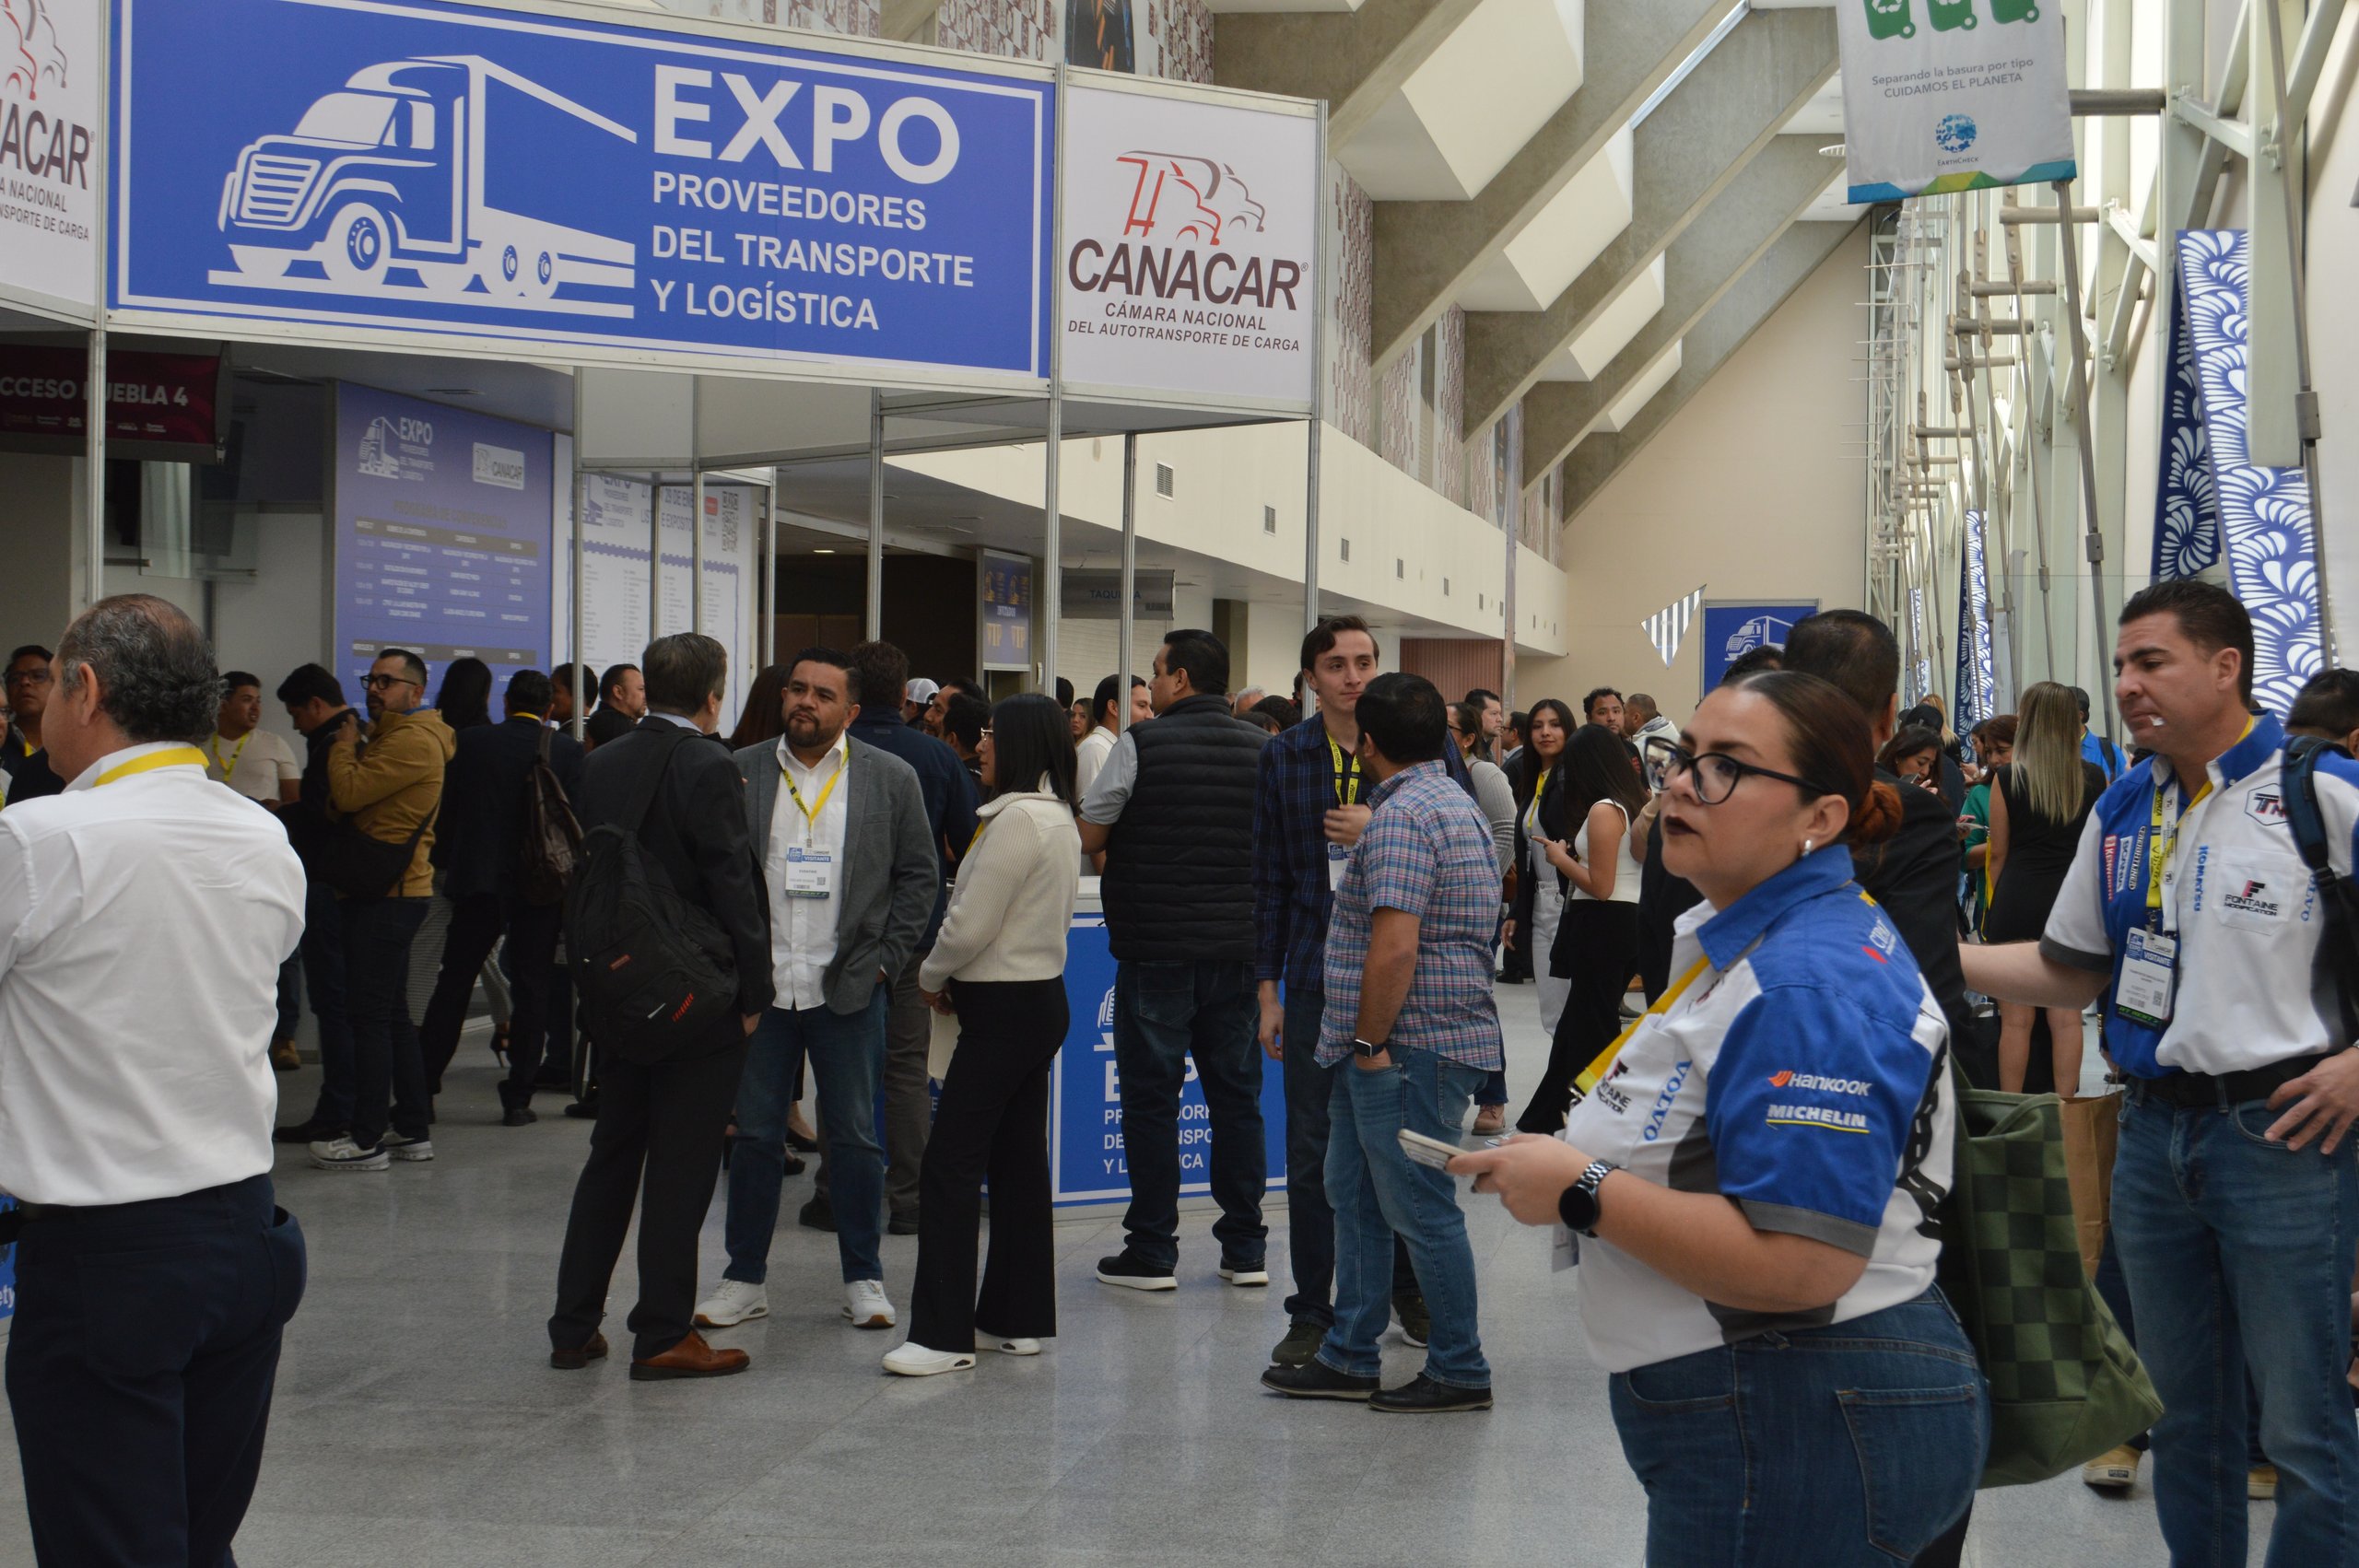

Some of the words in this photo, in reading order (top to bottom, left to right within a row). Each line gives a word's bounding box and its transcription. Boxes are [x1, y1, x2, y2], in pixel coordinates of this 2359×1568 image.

[1872, 69, 1931, 87] Separando
[1934, 67, 1944, 78] la
[1947, 64, 1984, 76] basura
[1988, 61, 2008, 75] por
[2011, 58, 2034, 72] tipo
[1884, 81, 1949, 99] CUIDAMOS
[1952, 79, 1966, 90] EL
[1969, 73, 2024, 88] PLANETA
[653, 64, 960, 184] EXPO
[0, 99, 89, 190] ACAR
[10, 178, 67, 213] NACIONAL
[652, 170, 927, 230] PROVEEDORES
[43, 215, 56, 232] DE
[58, 219, 89, 241] CARGA
[652, 225, 725, 263] DEL
[734, 232, 974, 287] TRANSPORTE
[1068, 239, 1301, 310] CANACAR
[651, 278, 676, 312] Y
[687, 281, 880, 331] LOGÍSTICA
[1105, 300, 1177, 323] CÁMARA
[1183, 309, 1267, 331] NACIONAL
[1068, 320, 1095, 334] DEL
[1099, 322, 1227, 346] AUTOTRANSPORTE
[1232, 333, 1250, 347] DE
[1254, 335, 1300, 351] CARGA
[83, 380, 169, 405] EBLA
[173, 386, 189, 406] 4
[400, 417, 433, 445] EXPO
[2194, 845, 2209, 912] KOMATSU
[2224, 894, 2279, 911] FONTAINE
[2224, 902, 2278, 917] MODIFICATION
[1643, 1059, 1693, 1141] VOLVO
[1767, 1105, 1867, 1128] MICHELIN
[1104, 1134, 1125, 1150] DE
[1103, 1159, 1115, 1175] Y
